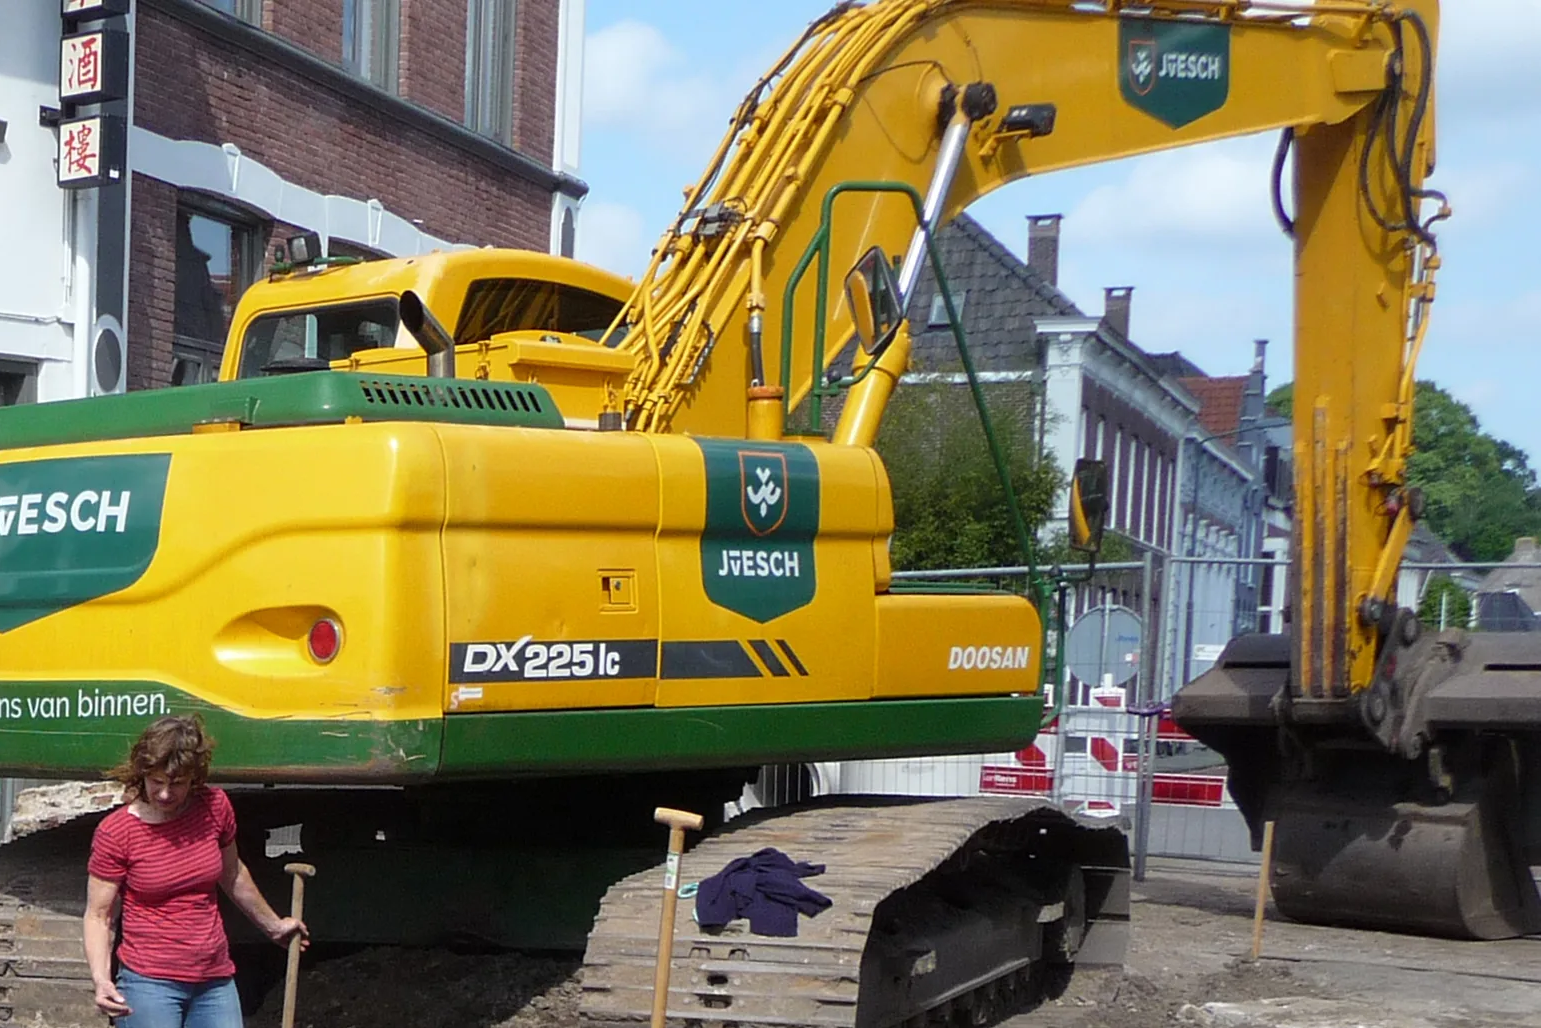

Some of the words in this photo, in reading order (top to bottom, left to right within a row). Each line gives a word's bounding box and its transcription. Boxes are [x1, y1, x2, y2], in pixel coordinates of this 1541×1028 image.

[947, 645, 1030, 670] DOOSAN
[27, 695, 70, 718] van
[77, 688, 171, 718] binnen.
